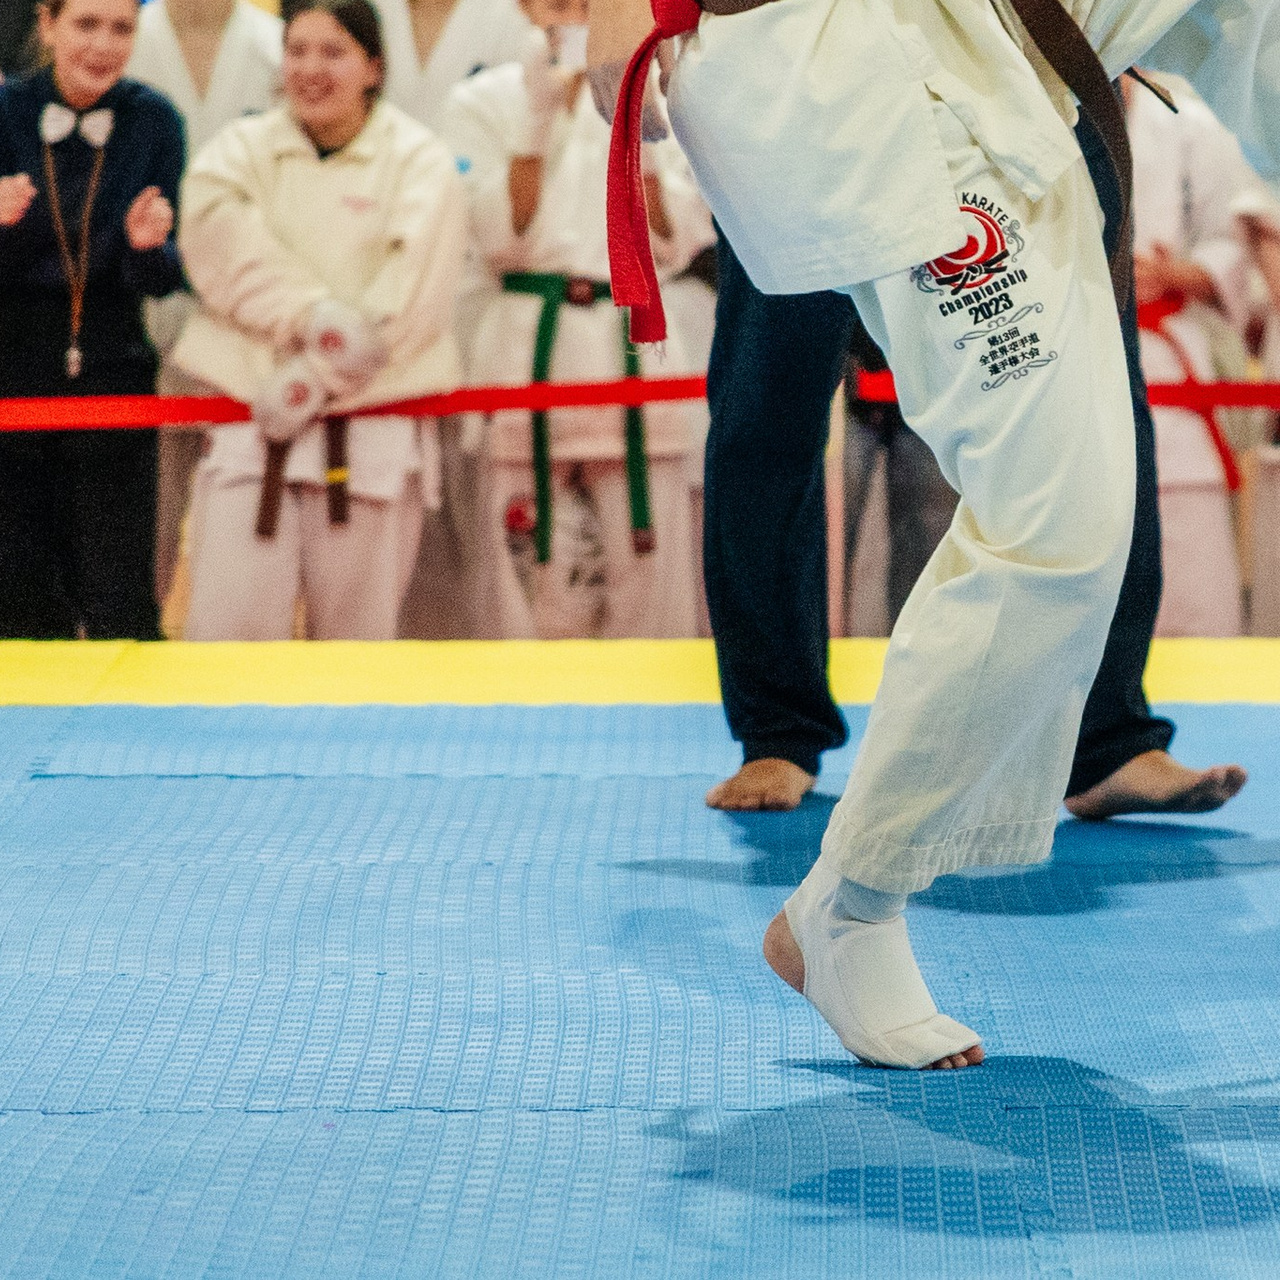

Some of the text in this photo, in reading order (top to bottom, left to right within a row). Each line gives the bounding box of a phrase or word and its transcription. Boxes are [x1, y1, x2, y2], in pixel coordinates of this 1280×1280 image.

[961, 191, 1009, 226] KARATE
[938, 269, 1028, 317] Championship
[968, 292, 1014, 325] 2023
